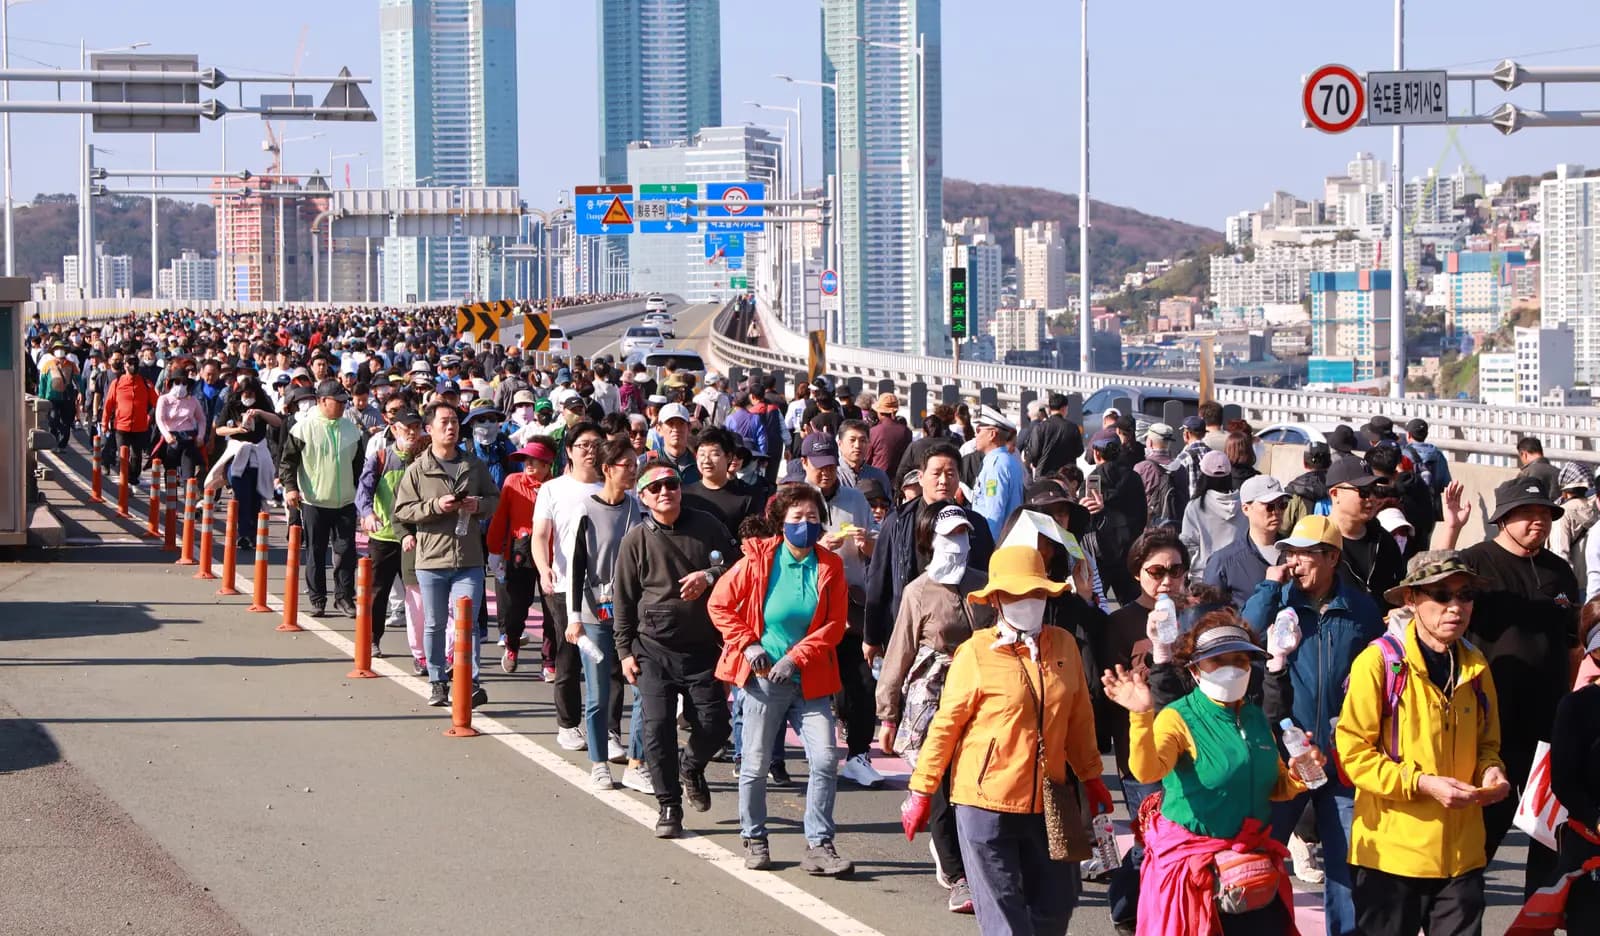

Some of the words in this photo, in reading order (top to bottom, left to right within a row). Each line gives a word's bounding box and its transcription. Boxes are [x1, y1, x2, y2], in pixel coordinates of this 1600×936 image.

[1319, 83, 1350, 116] 70
[1373, 81, 1401, 115] 속도를
[1404, 80, 1443, 114] 지키시오
